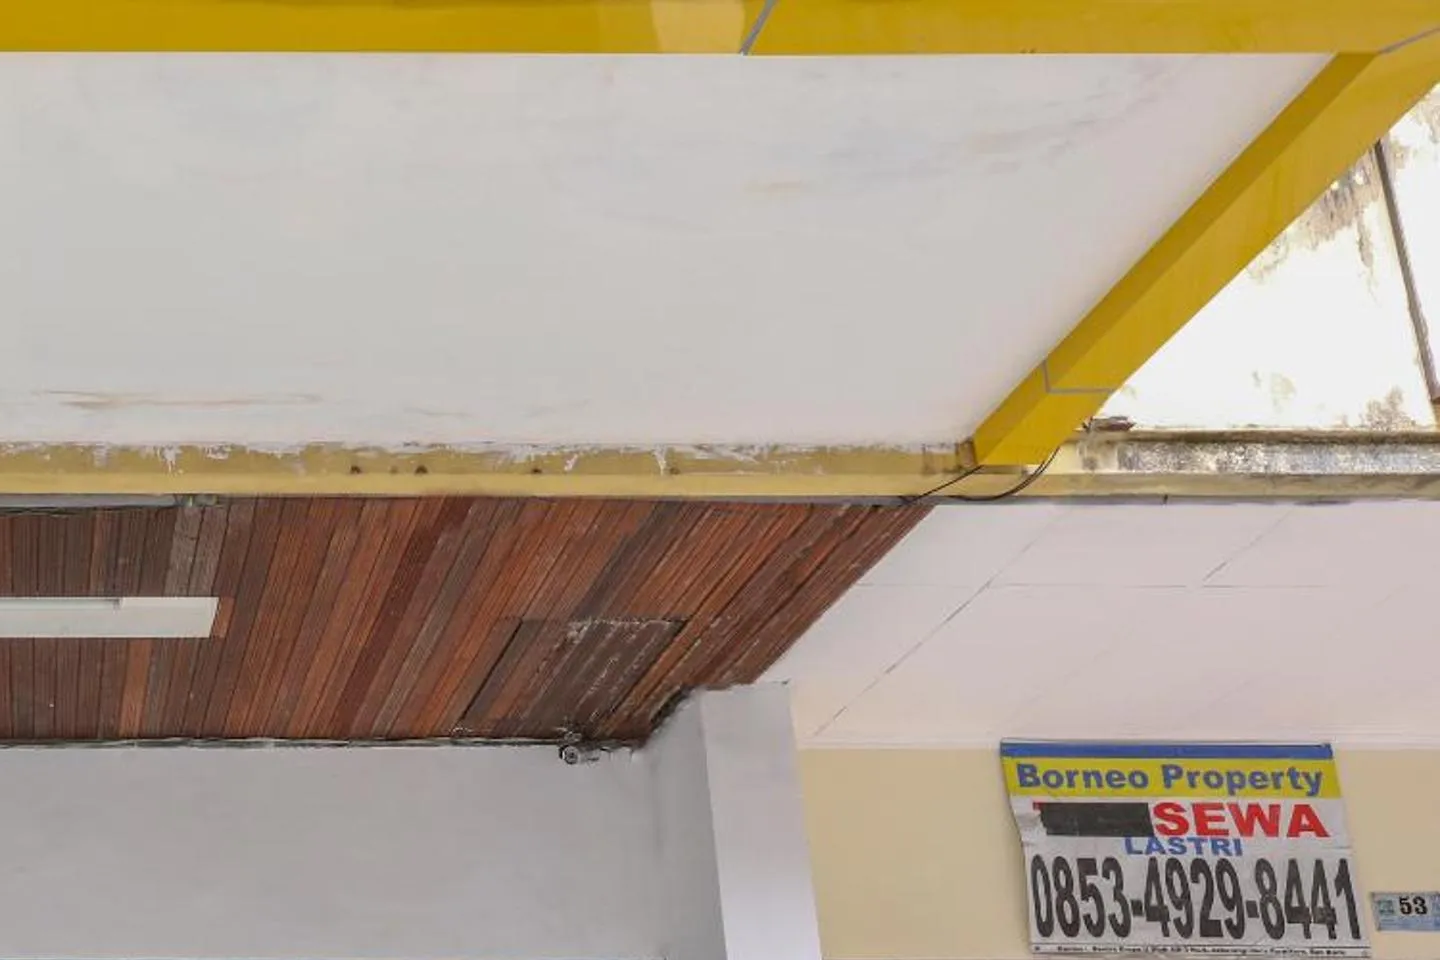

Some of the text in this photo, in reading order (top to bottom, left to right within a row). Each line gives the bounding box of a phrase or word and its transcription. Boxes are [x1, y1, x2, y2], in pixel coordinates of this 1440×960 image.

[1017, 763, 1323, 796] Borneo Property
[1152, 802, 1330, 838] SEWA
[1125, 836, 1243, 857] LASTRI
[1030, 854, 1362, 940] 0853-4929-8441
[1398, 896, 1428, 915] 53
